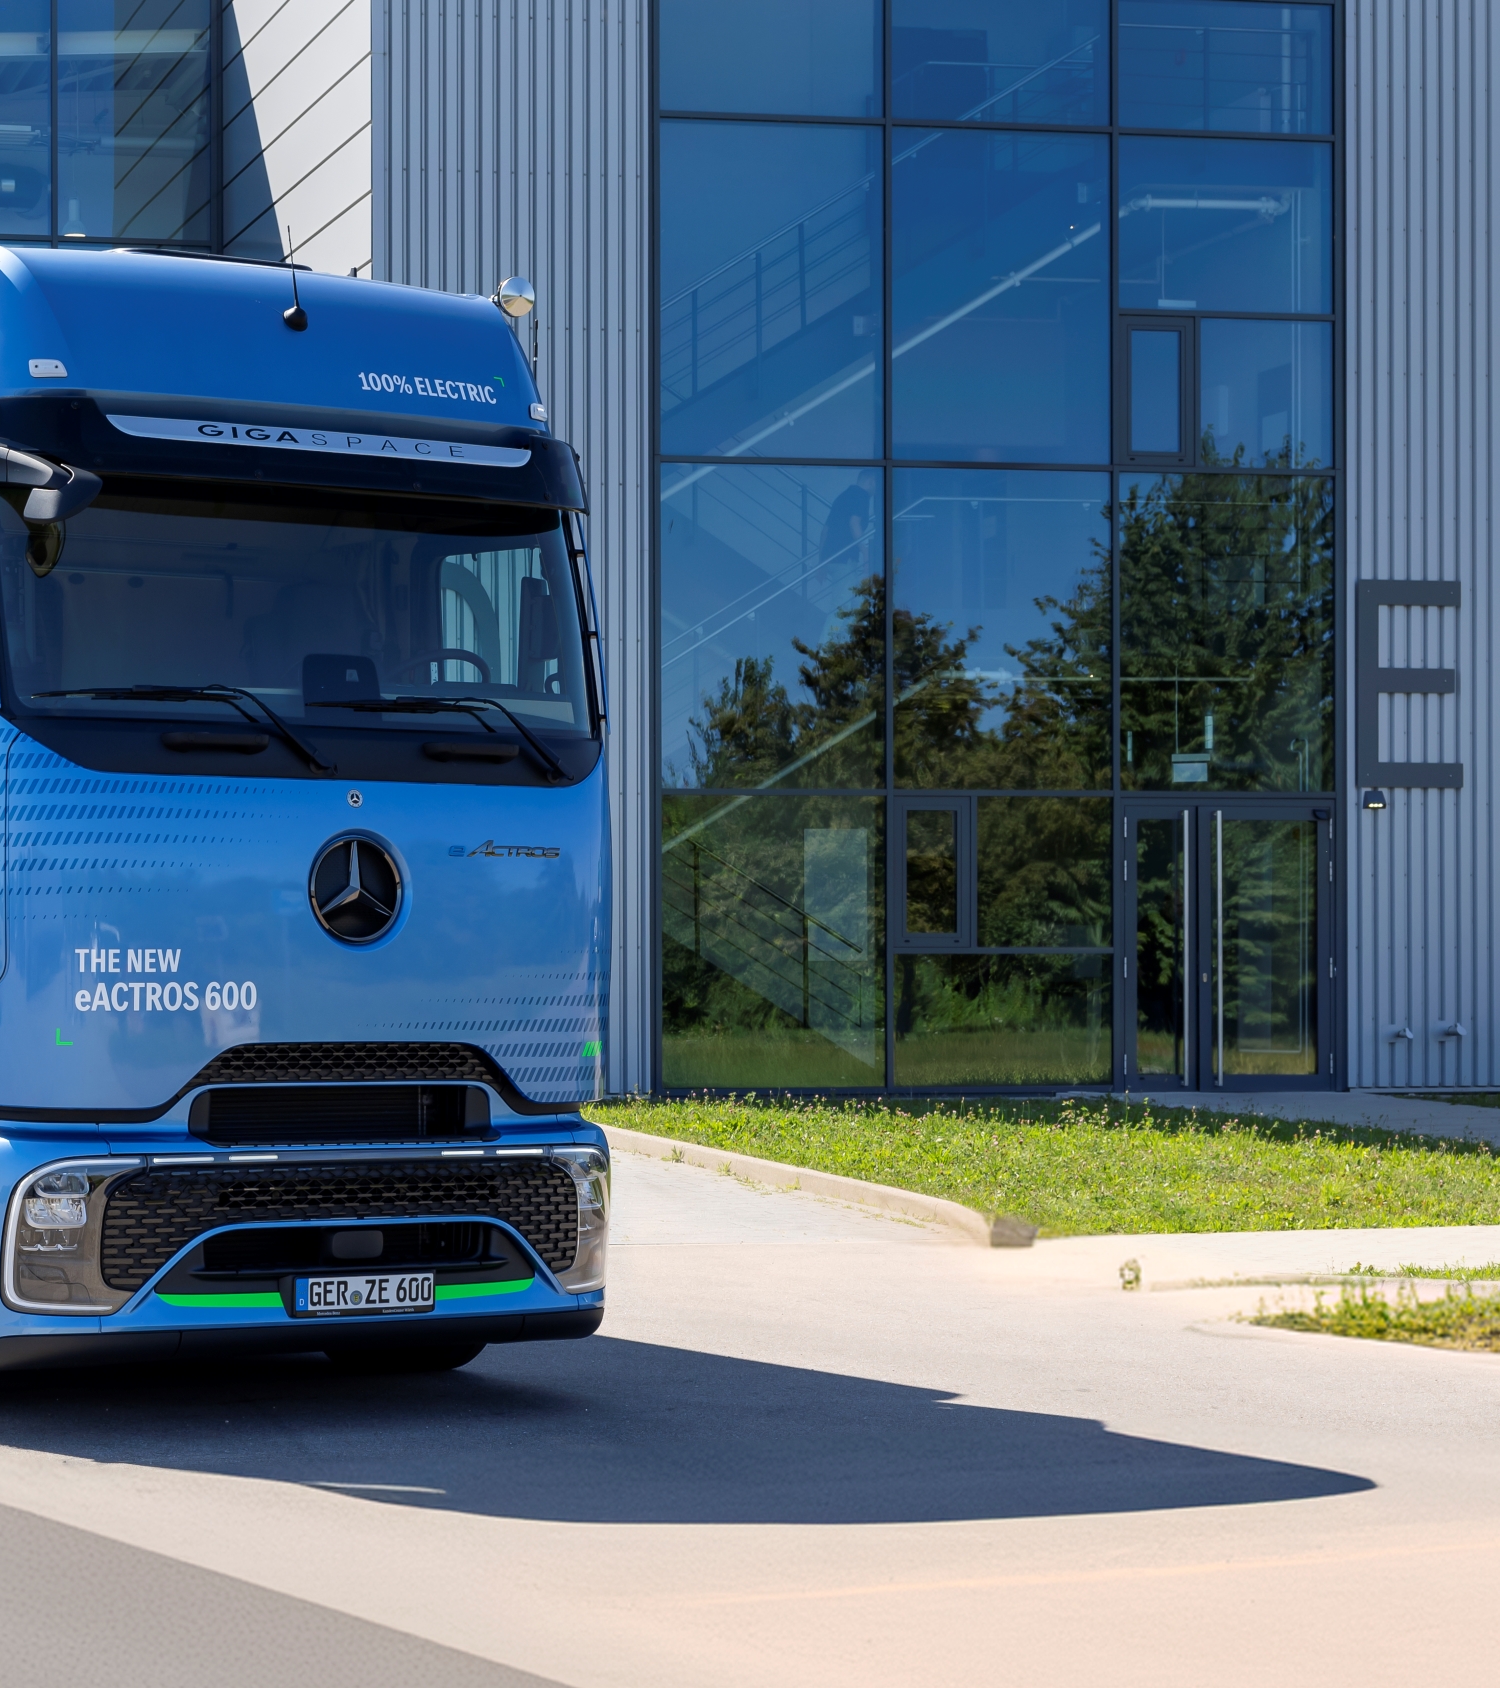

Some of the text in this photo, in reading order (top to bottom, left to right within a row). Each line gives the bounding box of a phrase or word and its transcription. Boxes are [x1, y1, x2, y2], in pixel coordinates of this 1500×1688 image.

[358, 371, 497, 405] 100% ELECTRIC
[1356, 579, 1464, 788] E
[75, 948, 181, 973] THE NEW
[75, 981, 257, 1011] eACTROS 600
[299, 1298, 305, 1306] D
[309, 1276, 432, 1307] GER ZE 600
